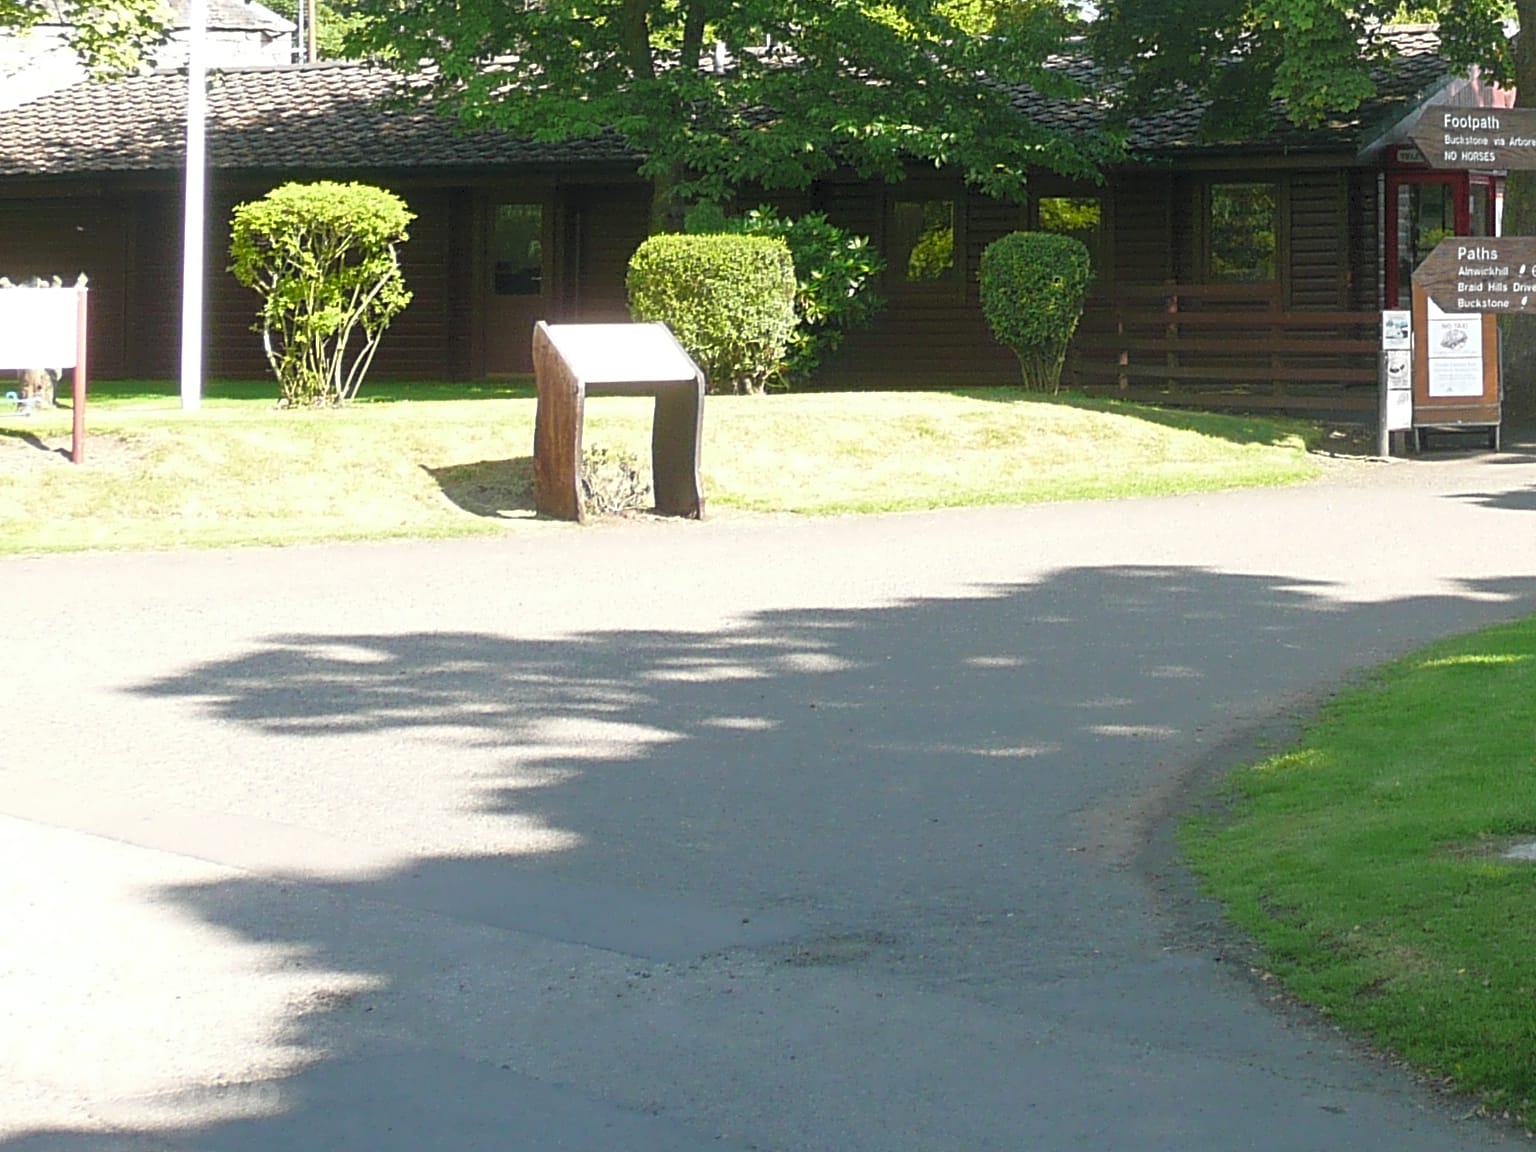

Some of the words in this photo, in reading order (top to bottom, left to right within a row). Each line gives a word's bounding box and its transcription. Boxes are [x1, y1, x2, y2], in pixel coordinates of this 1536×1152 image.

[1444, 113, 1500, 131] Footpath
[1444, 134, 1489, 145] Buckstone
[1494, 137, 1505, 146] via
[1444, 151, 1457, 161] NO
[1461, 151, 1496, 162] HORSES
[1458, 246, 1498, 260] Paths
[1458, 266, 1509, 276] Alnwickhill
[1457, 282, 1483, 292] Braid
[1488, 282, 1508, 292] Hills
[1457, 298, 1510, 308] Buckstone
